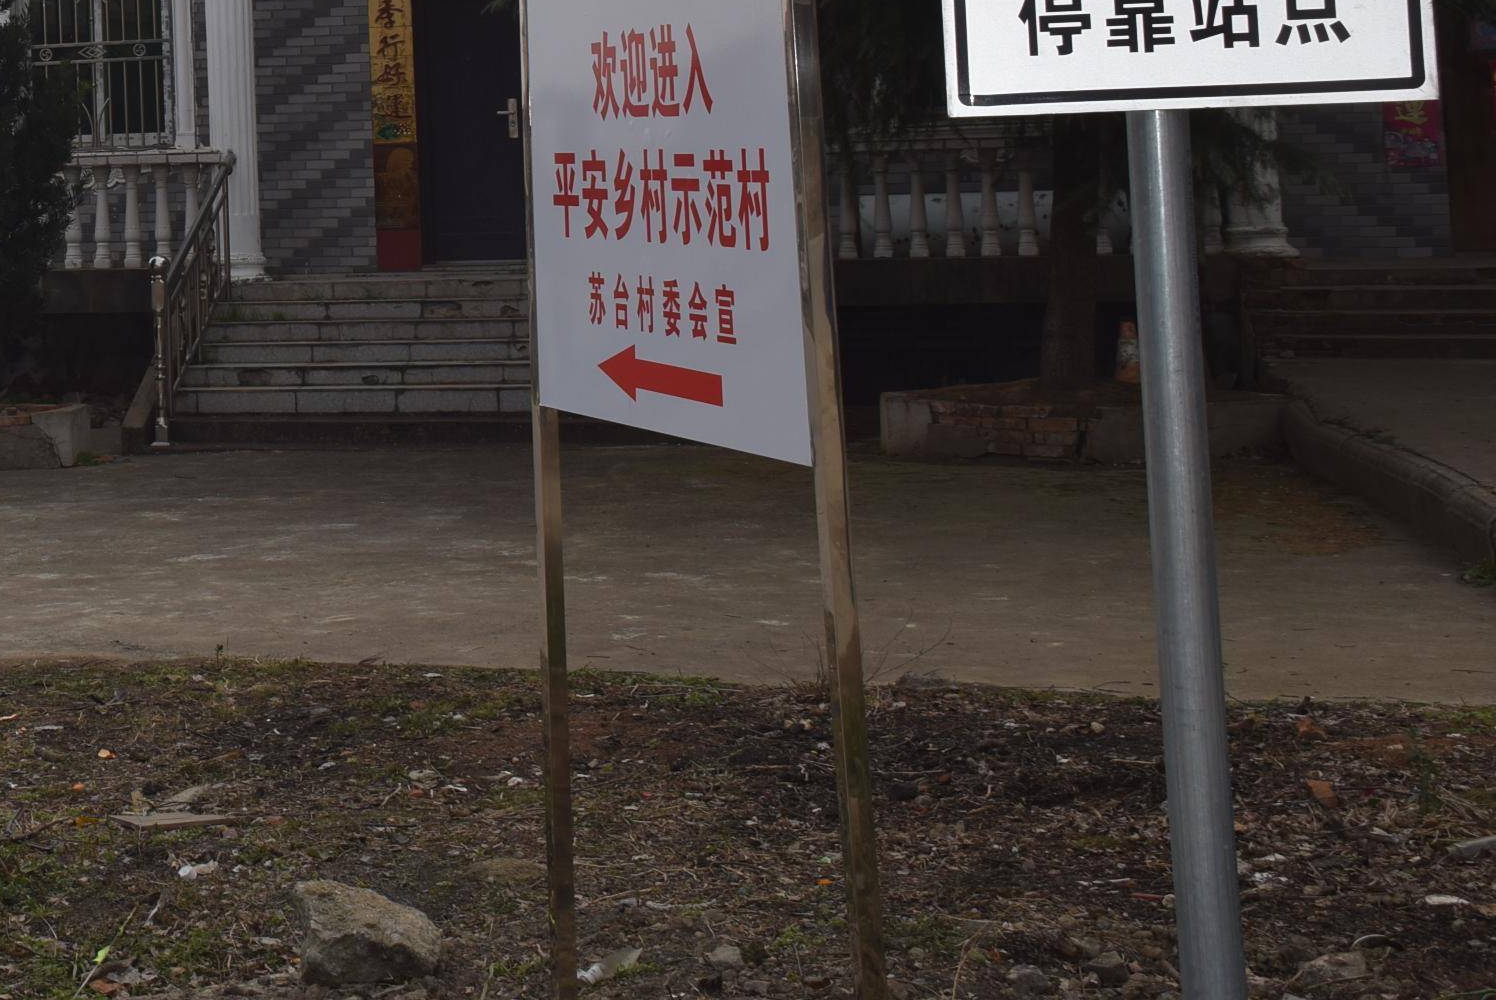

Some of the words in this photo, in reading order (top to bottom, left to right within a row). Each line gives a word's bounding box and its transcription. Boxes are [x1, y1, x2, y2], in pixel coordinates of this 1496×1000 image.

[591, 24, 713, 121] 欢迎进入
[553, 148, 770, 251] 平安乡村示范村
[588, 271, 737, 345] 苏台村委会宣
